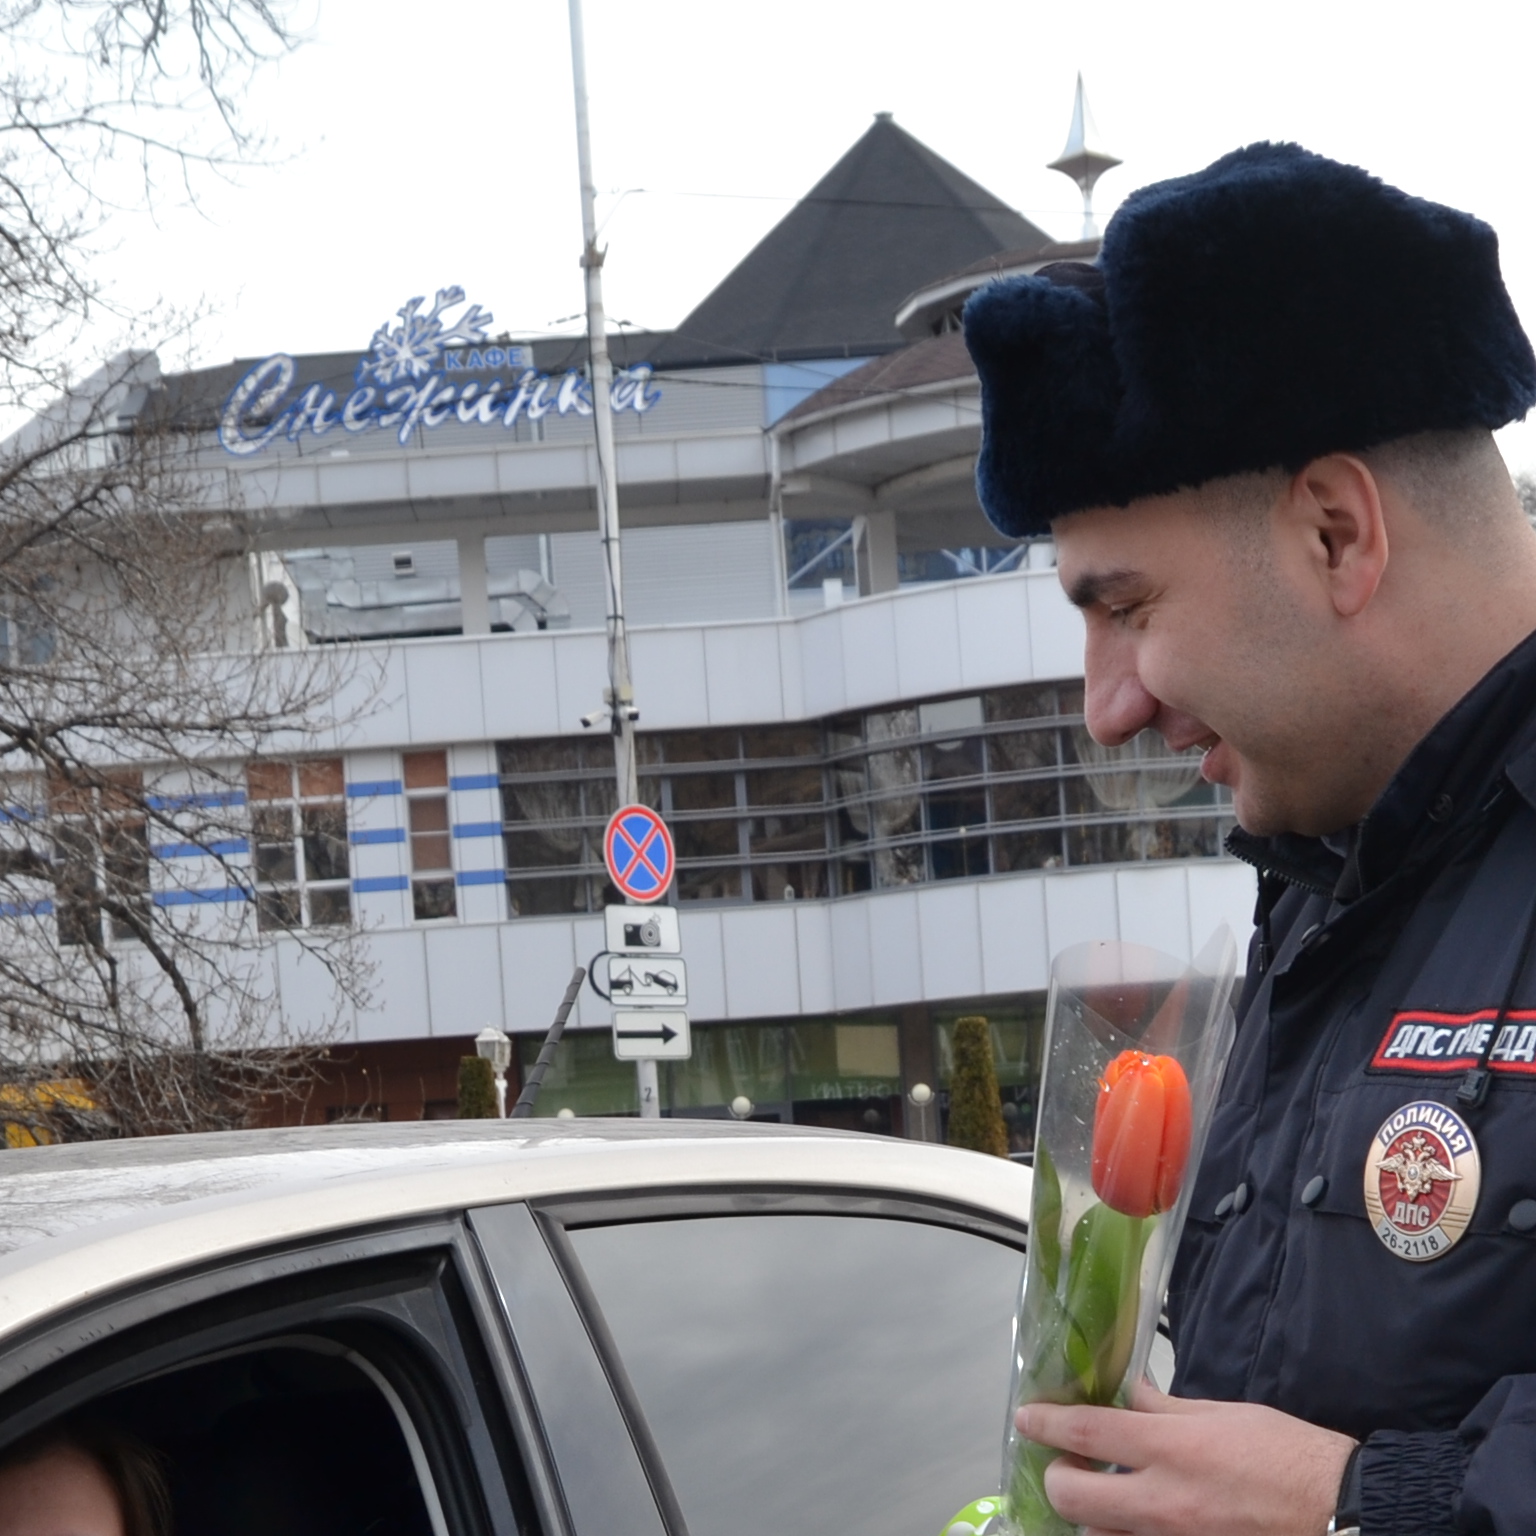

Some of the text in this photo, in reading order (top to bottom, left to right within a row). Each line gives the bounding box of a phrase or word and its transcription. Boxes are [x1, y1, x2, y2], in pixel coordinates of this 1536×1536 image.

[445, 345, 524, 370] КАФЕ
[218, 352, 662, 455] Снежинка
[1383, 1024, 1452, 1059] ДПС
[1382, 1105, 1468, 1153] ПОЛИЦИЯ
[1392, 1201, 1431, 1227] ДПС
[1382, 1227, 1440, 1256] 26-2118
